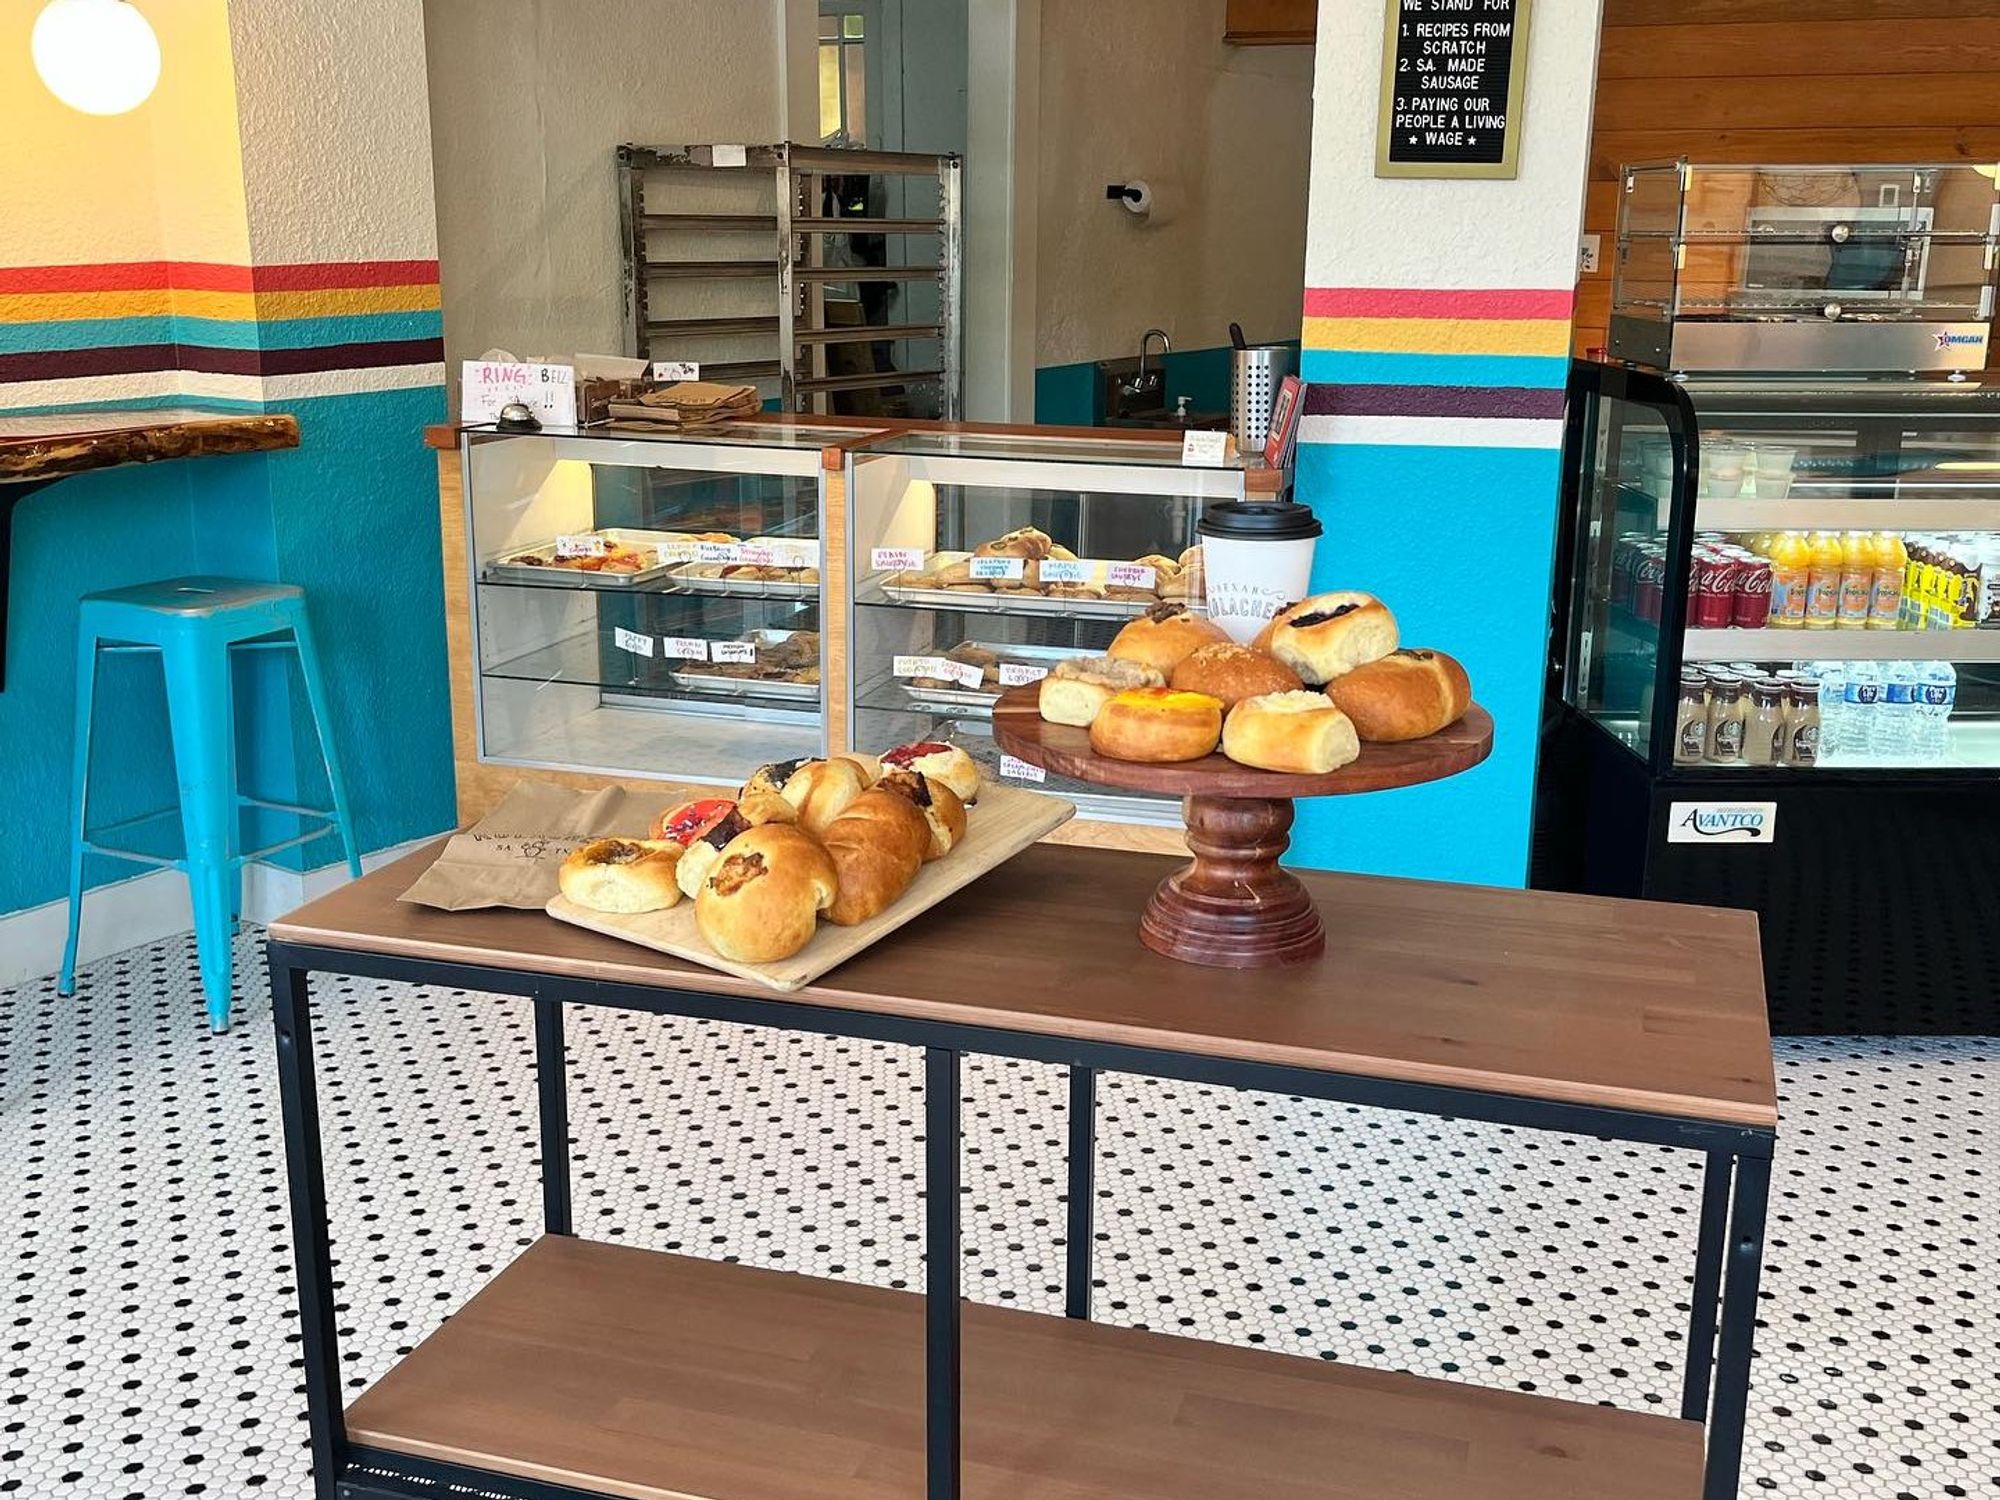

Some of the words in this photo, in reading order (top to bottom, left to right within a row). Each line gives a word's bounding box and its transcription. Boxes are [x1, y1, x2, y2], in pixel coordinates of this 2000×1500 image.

[1402, 0, 1422, 11] WE
[1430, 0, 1473, 11] STAND
[1484, 0, 1510, 11] FOR
[1402, 24, 1410, 37] 1.
[1416, 23, 1469, 37] RECIPES
[1473, 23, 1511, 37] FROM
[1423, 41, 1486, 55] SCRATCH
[1399, 58, 1411, 72] 2.
[1447, 58, 1486, 72] MADE
[1421, 76, 1480, 90] SAUSAGE
[1396, 97, 1408, 111] 3.
[1412, 97, 1459, 111] PAYING
[1463, 97, 1490, 111] OUR
[1396, 115, 1446, 128] PEOPLE
[1451, 115, 1460, 128] A
[1465, 115, 1506, 129] LIVING
[1425, 132, 1464, 145] WAGE
[482, 366, 526, 384] RING
[541, 368, 568, 384] BELL
[1208, 597, 1275, 620] OLACHE
[1680, 808, 1764, 837] AVANTCO
